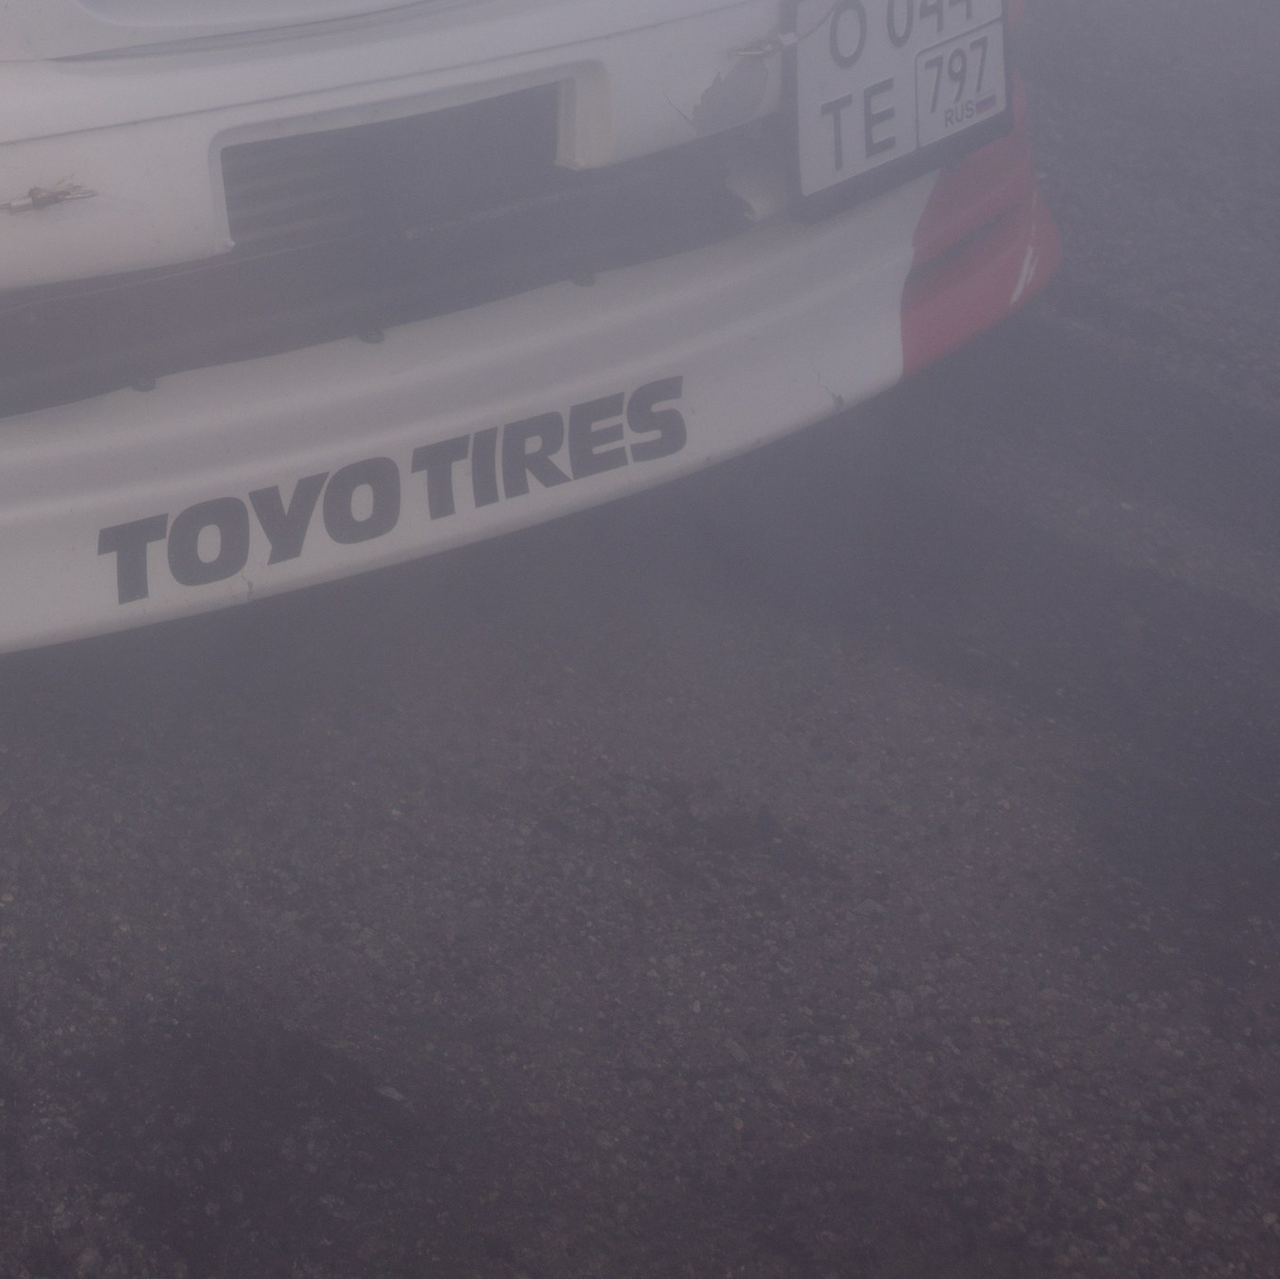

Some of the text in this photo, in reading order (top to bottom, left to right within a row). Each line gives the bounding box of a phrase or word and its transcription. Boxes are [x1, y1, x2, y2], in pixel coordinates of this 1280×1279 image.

[820, 35, 989, 172] TE 797
[944, 100, 975, 128] RUS
[96, 375, 687, 606] TOYO TIRES
